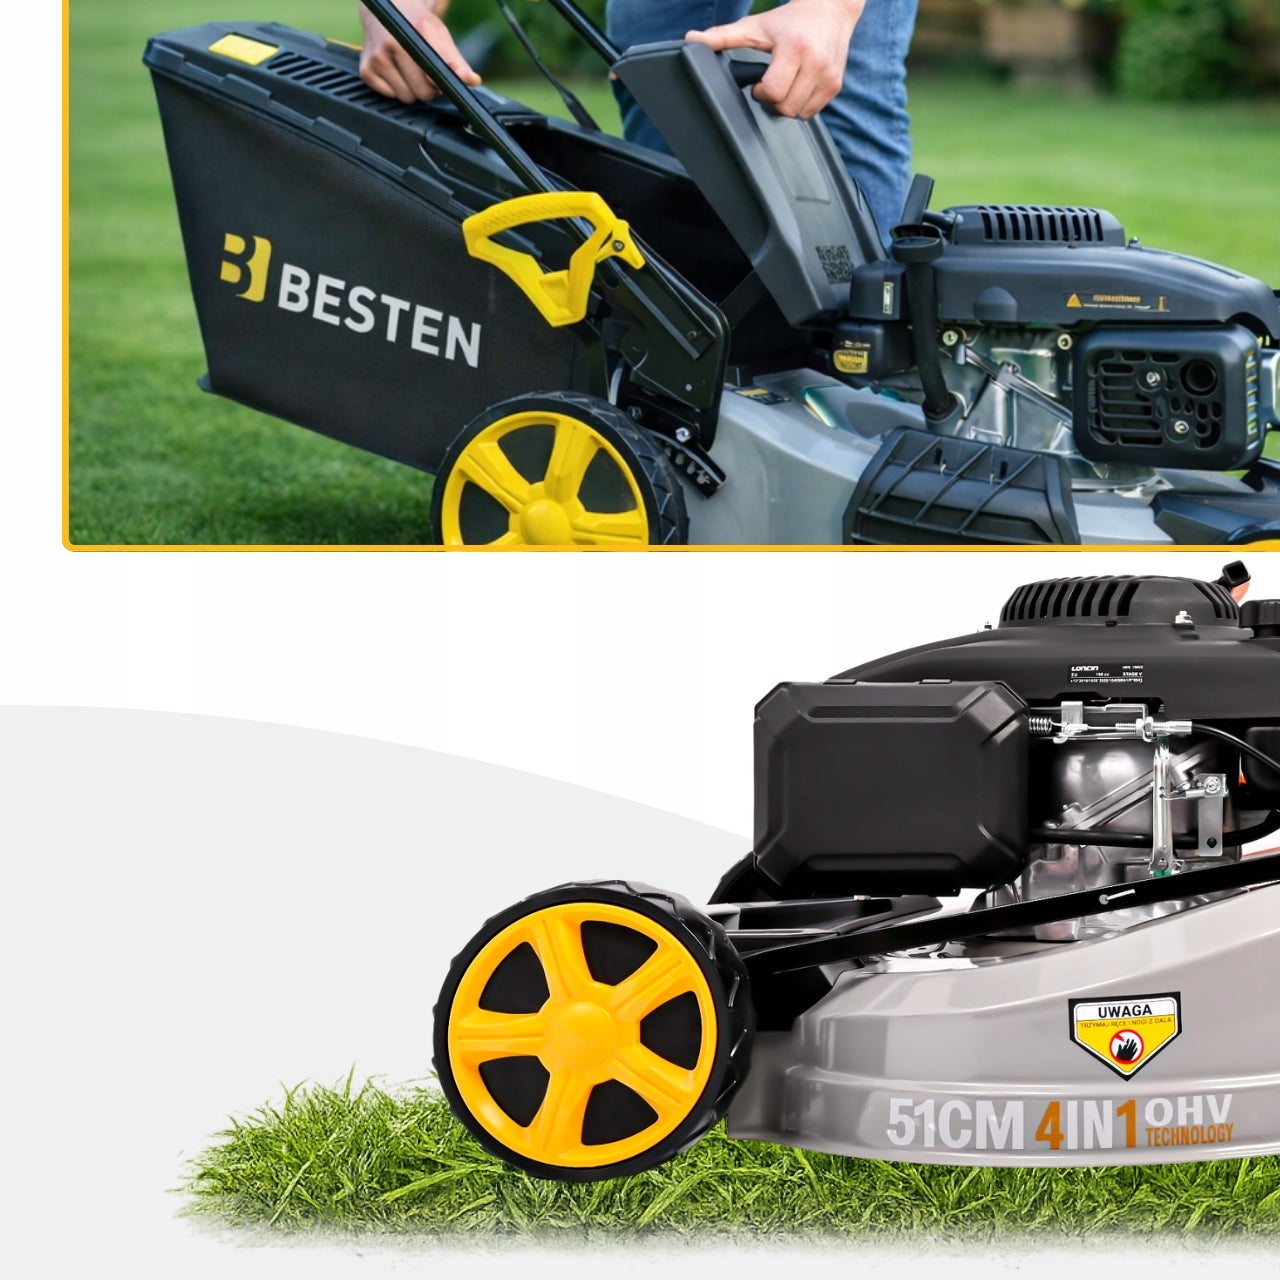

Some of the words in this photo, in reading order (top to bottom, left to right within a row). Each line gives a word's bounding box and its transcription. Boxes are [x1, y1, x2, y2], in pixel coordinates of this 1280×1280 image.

[278, 263, 481, 368] BESTEN
[1098, 1004, 1152, 1018] UWAGA
[886, 1098, 1024, 1150] 51CM
[1035, 1098, 1136, 1150] 4IN1
[1145, 1094, 1233, 1127] OHV
[1145, 1123, 1235, 1148] TECHNOLOGY
